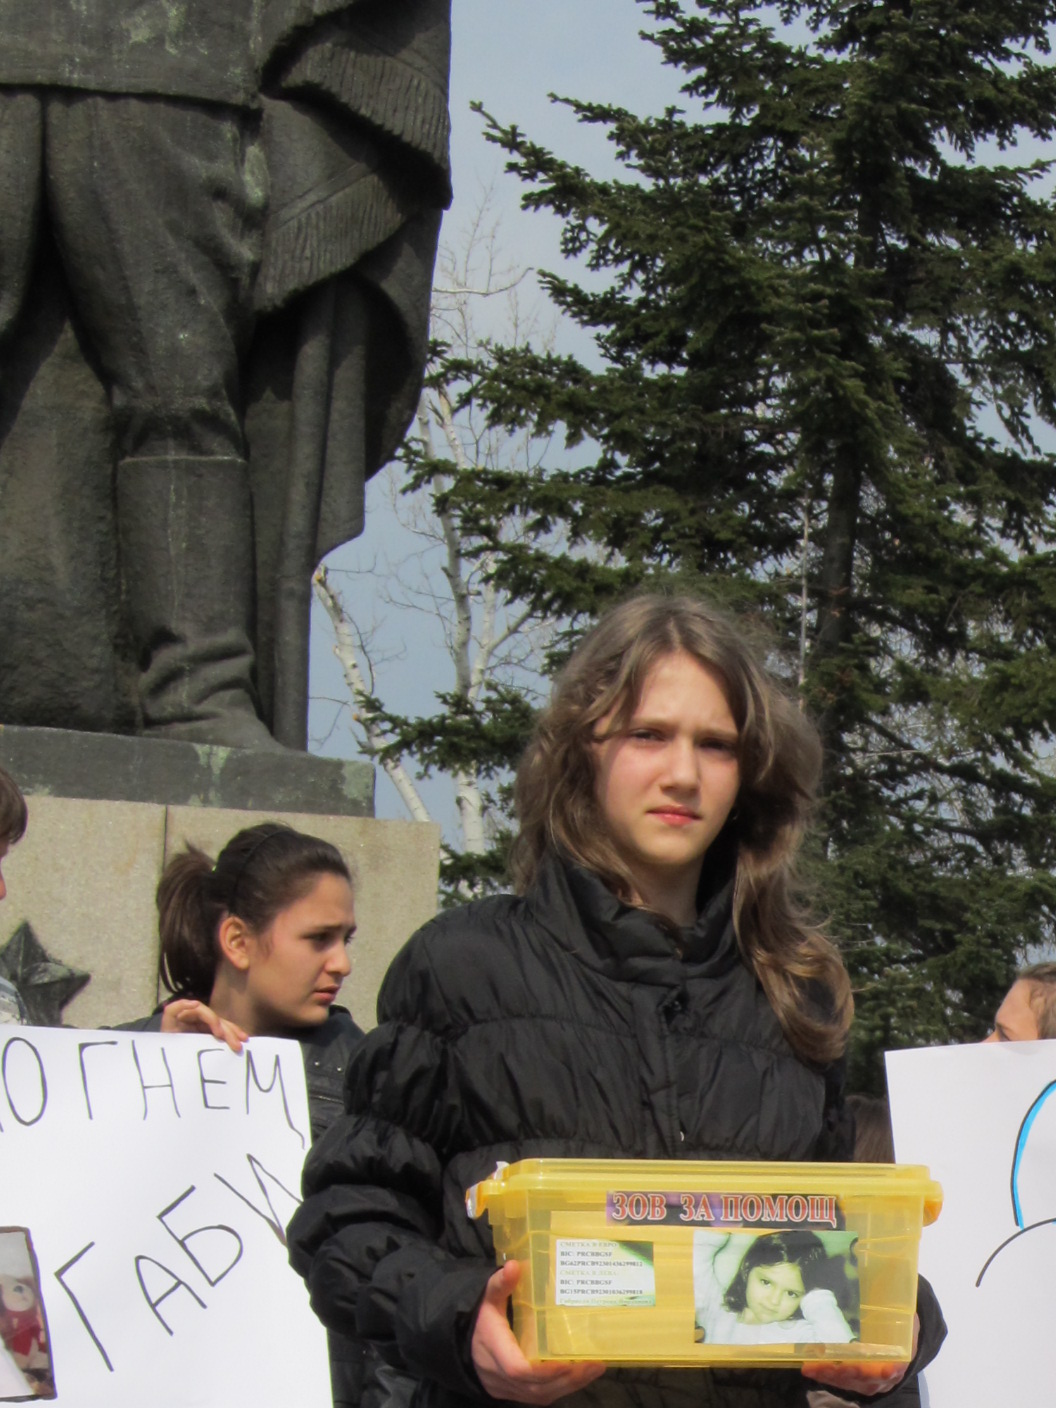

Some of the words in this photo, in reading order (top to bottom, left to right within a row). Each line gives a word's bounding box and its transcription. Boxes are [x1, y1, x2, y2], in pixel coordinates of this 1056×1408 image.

[0, 1036, 306, 1150] ОГНЕМ
[54, 1153, 304, 1373] ГАБИ
[612, 1193, 667, 1221] ЗОВ
[680, 1193, 715, 1222] ЗА
[720, 1194, 837, 1229] ПОМОЩ
